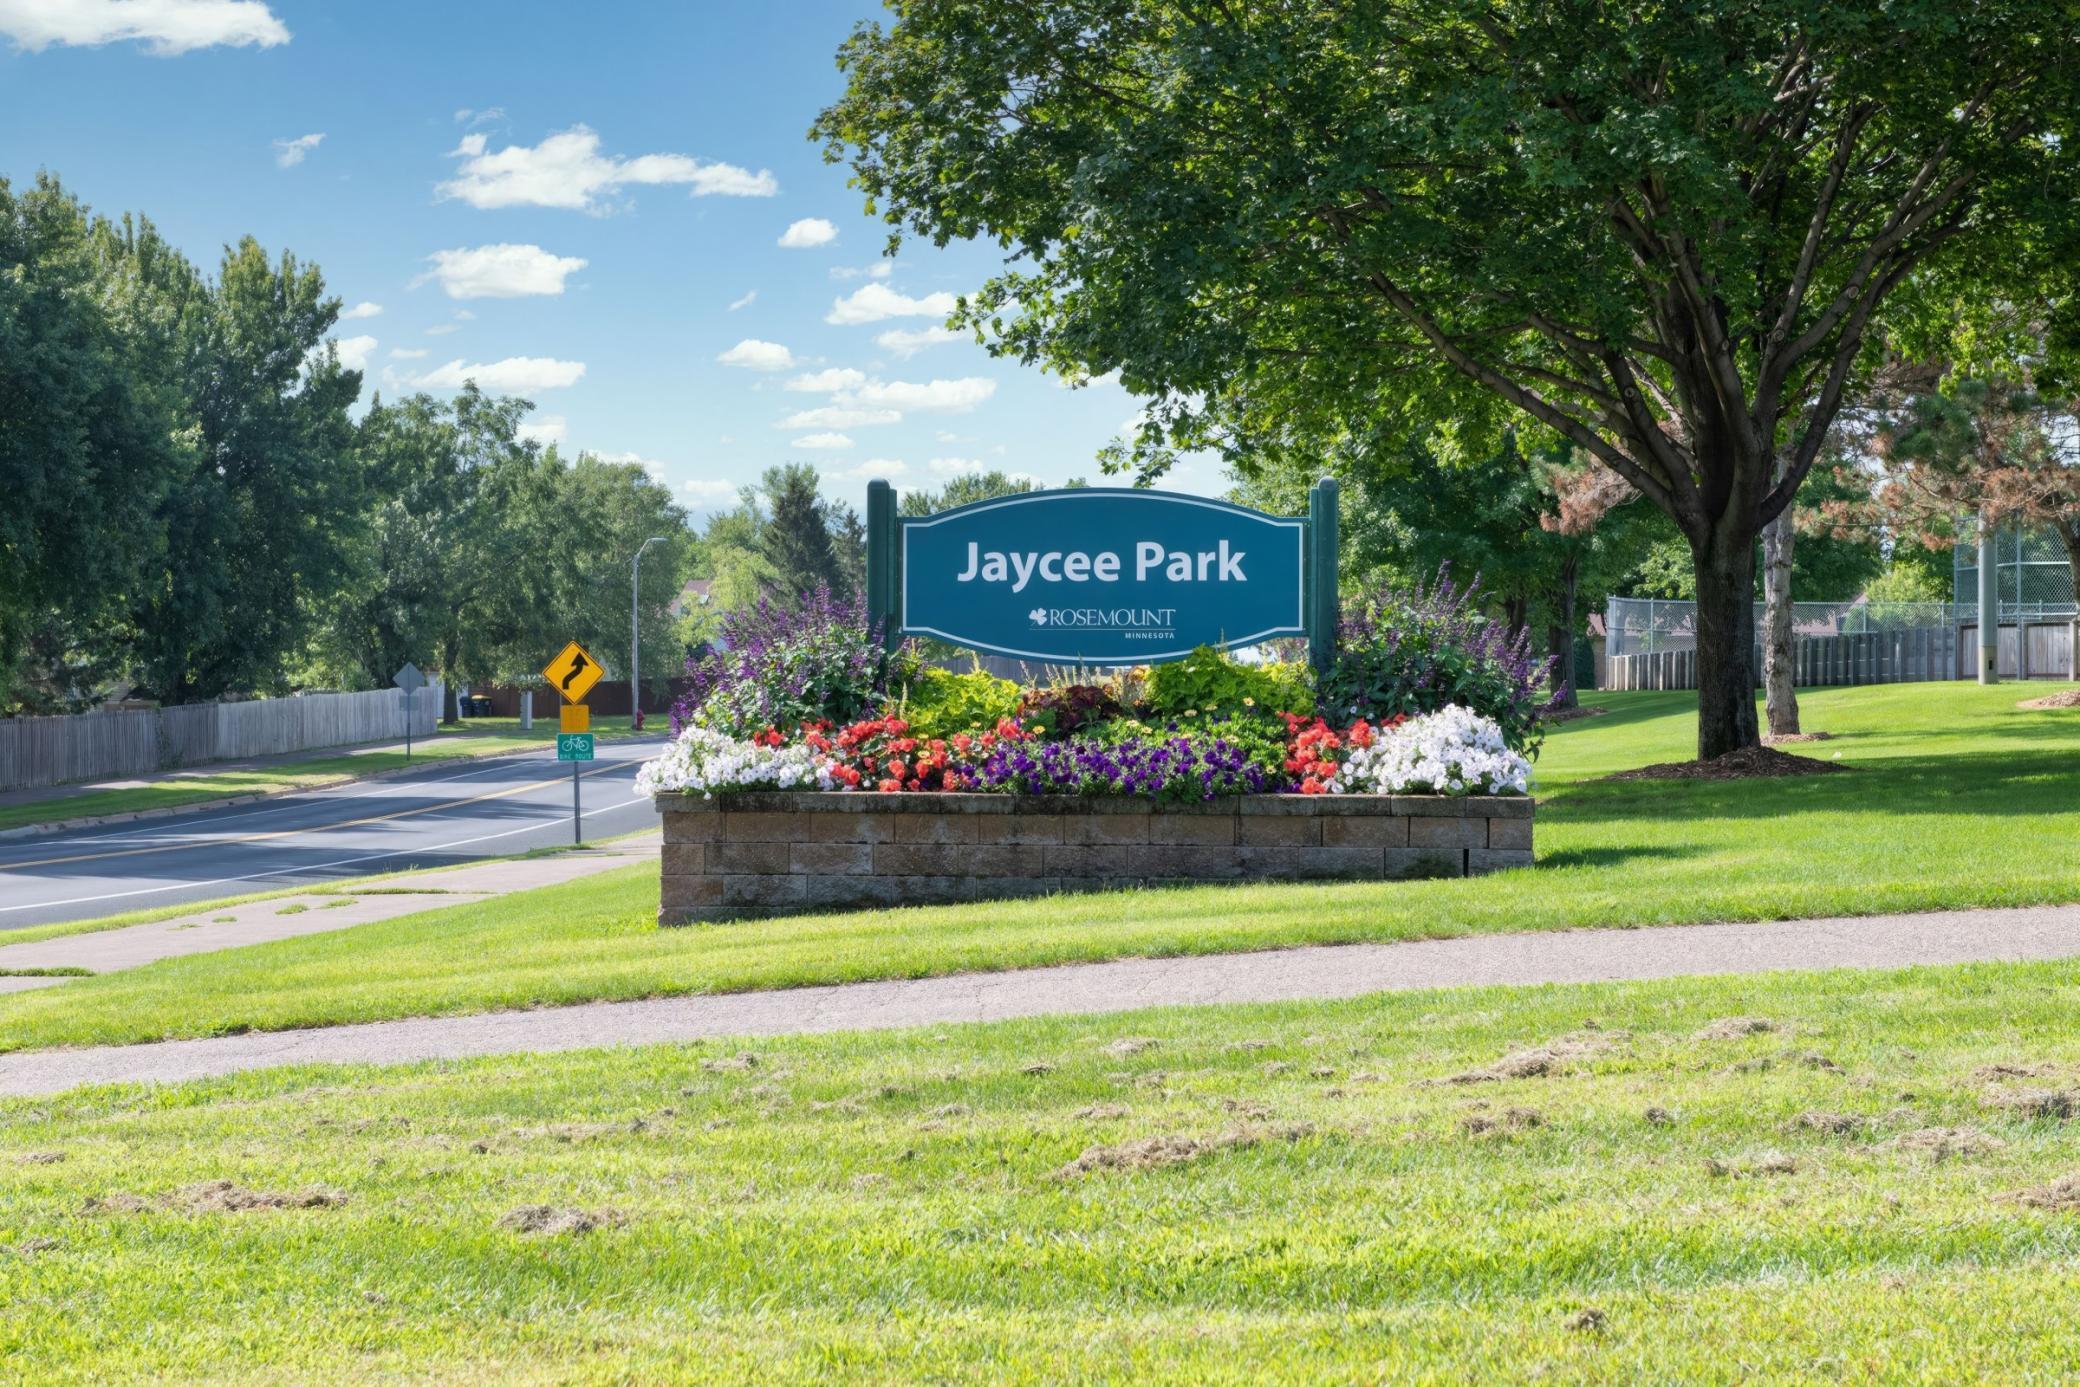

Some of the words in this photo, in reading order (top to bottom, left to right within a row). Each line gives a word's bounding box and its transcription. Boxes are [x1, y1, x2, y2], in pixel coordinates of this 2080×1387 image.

[957, 541, 1121, 593] Jaycee
[1136, 539, 1248, 582] Park
[1050, 608, 1177, 626] ROSEMOUNT
